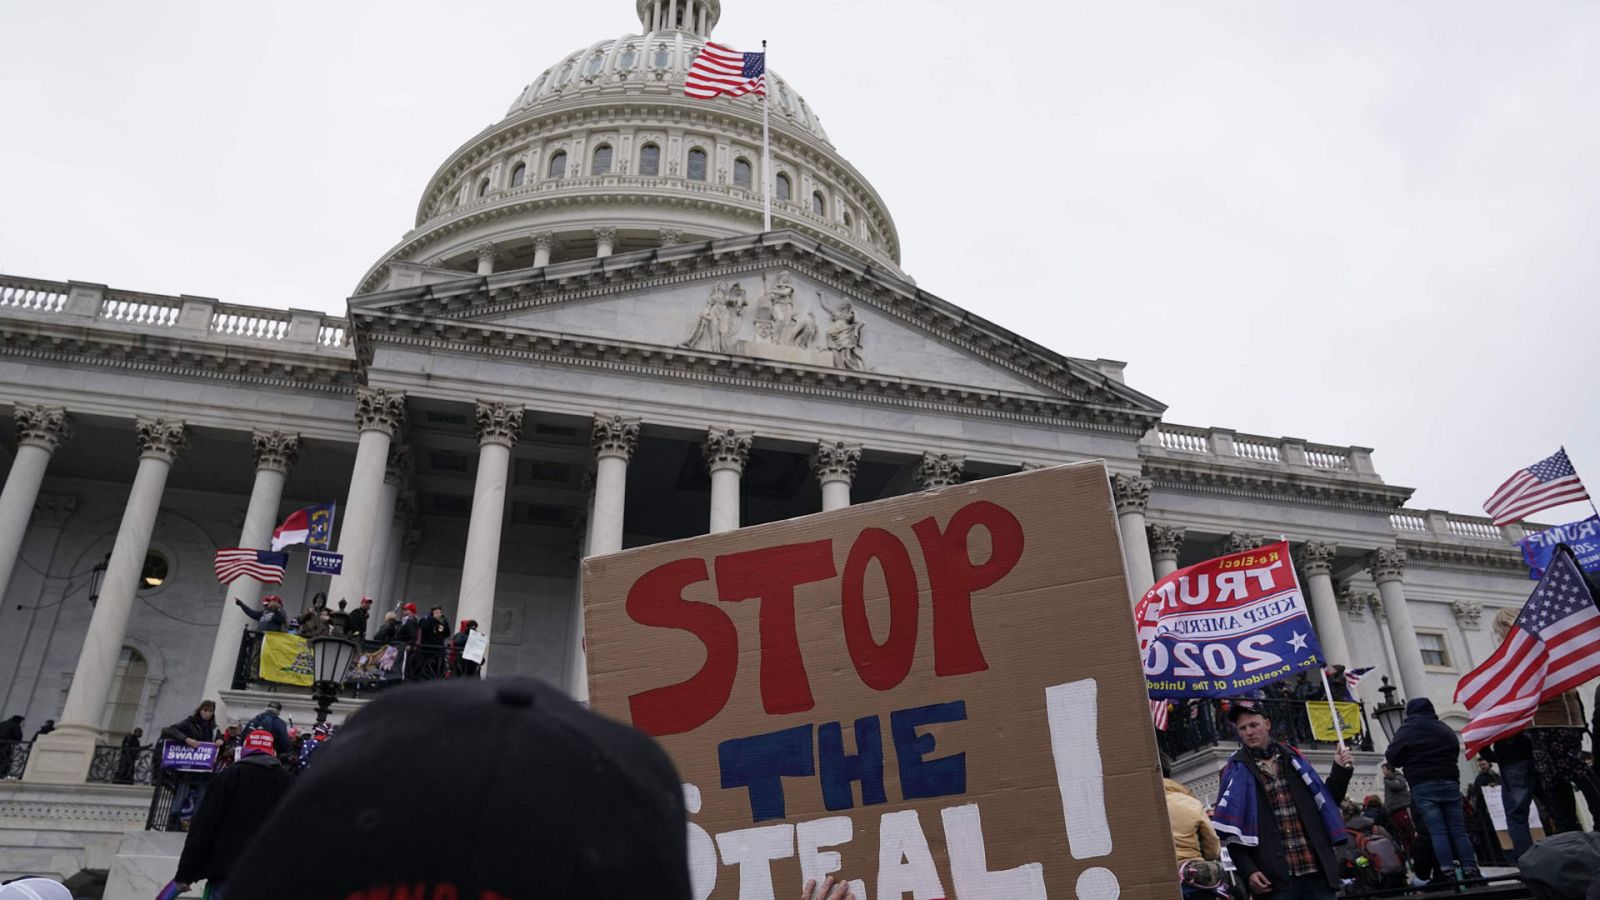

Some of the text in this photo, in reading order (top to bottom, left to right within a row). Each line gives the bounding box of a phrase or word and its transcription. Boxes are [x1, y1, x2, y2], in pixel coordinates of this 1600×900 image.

[311, 555, 342, 564] TRUMP
[626, 500, 1025, 737] STOP
[167, 752, 211, 761] SWAMP
[718, 700, 968, 823] THE
